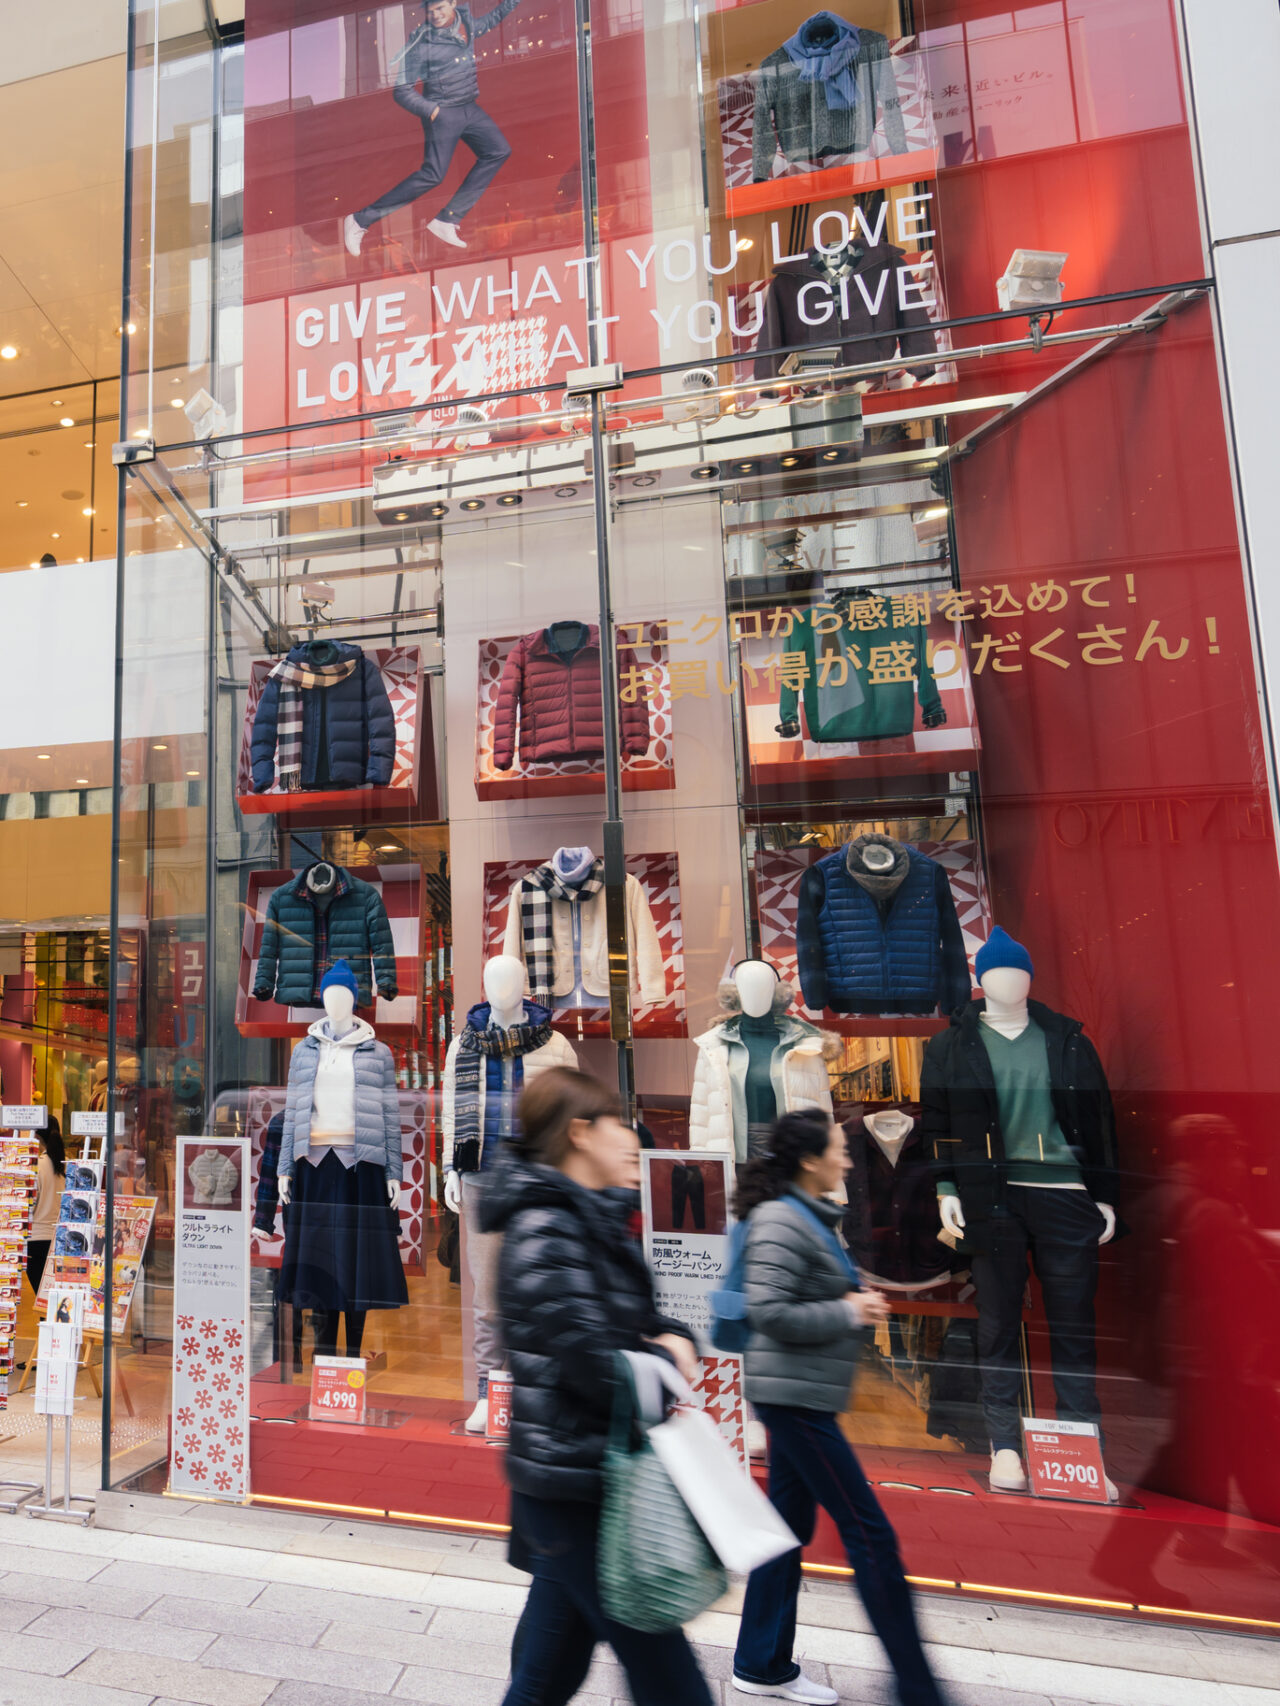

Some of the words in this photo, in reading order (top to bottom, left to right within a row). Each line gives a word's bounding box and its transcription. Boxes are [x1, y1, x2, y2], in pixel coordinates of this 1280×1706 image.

[295, 291, 406, 348] GIVE
[432, 257, 600, 324] WHAT
[626, 230, 738, 288] YOU
[770, 192, 936, 262] LOVE
[297, 350, 425, 409] LOVE
[452, 316, 619, 379] WHAT
[651, 291, 766, 350] YOU
[796, 261, 937, 326] GIVE
[433, 407, 455, 419] QLO
[617, 573, 1138, 650] ユニクロから感謝を込めて!
[618, 616, 1222, 703] お買い得が盛りだくさん!
[182, 1223, 233, 1234] ウルトラライト
[182, 1232, 205, 1242] ダウン
[652, 1247, 712, 1260] 防風ウォーム
[653, 1260, 722, 1271] イージーパンツ
[317, 1390, 357, 1408] ¥4,990
[1037, 1461, 1099, 1484] ¥12,900
